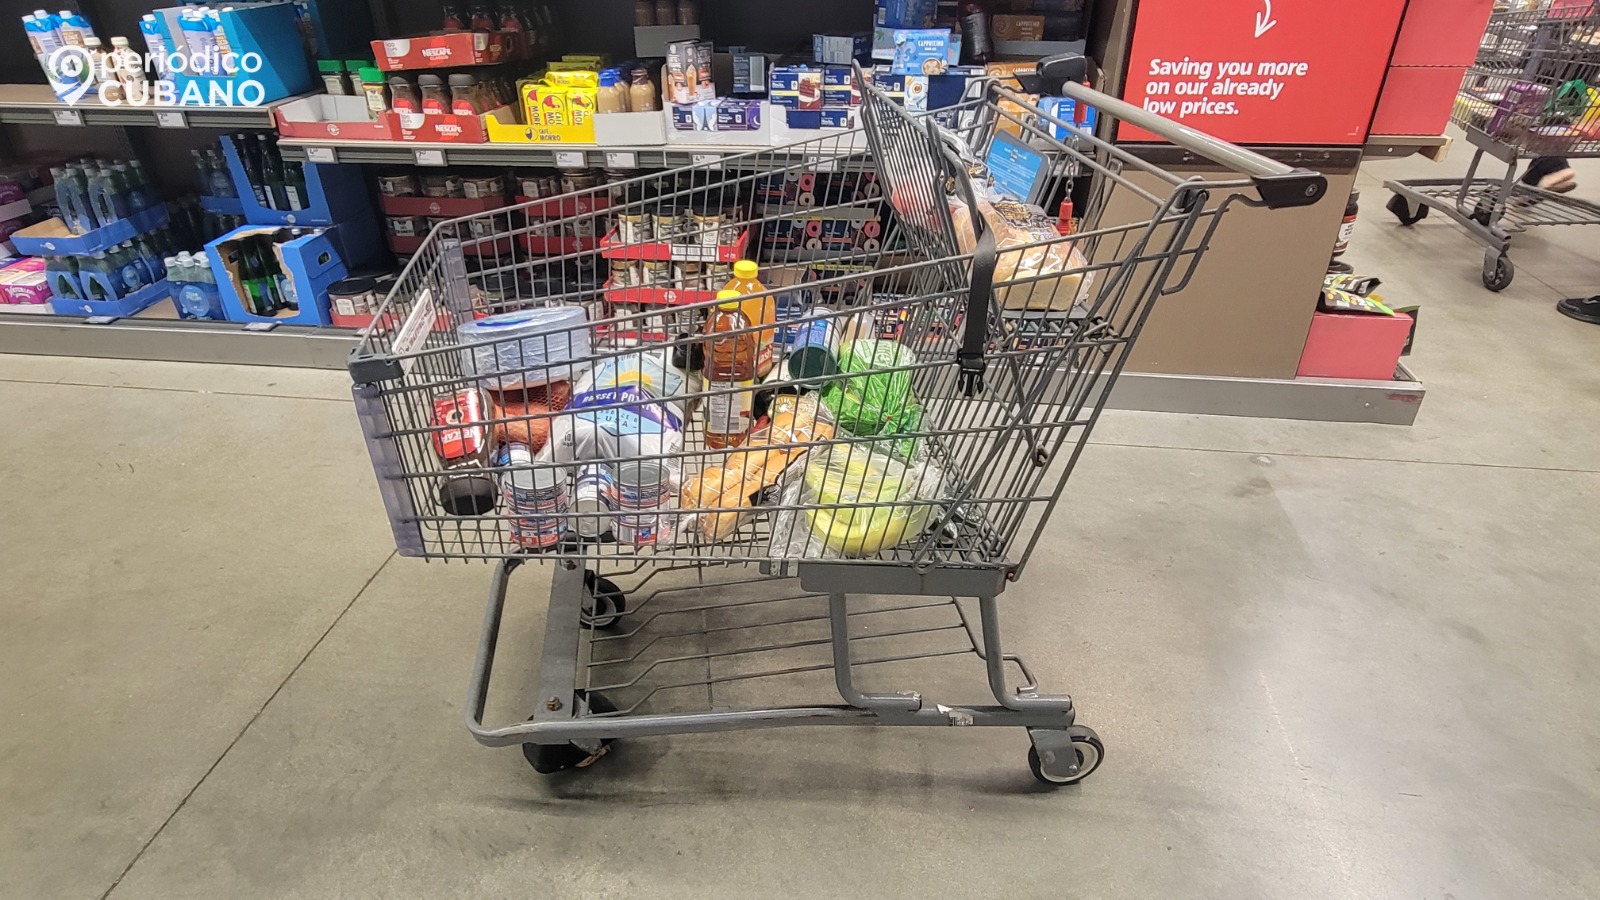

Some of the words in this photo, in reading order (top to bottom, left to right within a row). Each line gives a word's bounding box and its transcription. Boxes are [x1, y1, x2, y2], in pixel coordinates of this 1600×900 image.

[1149, 57, 1213, 79] Saving
[1216, 61, 1252, 79] you
[1257, 61, 1309, 76] more
[1146, 81, 1171, 95] on
[1174, 81, 1208, 95] our
[1211, 78, 1284, 100] already
[1143, 97, 1177, 115] low
[1179, 99, 1240, 118] prices.
